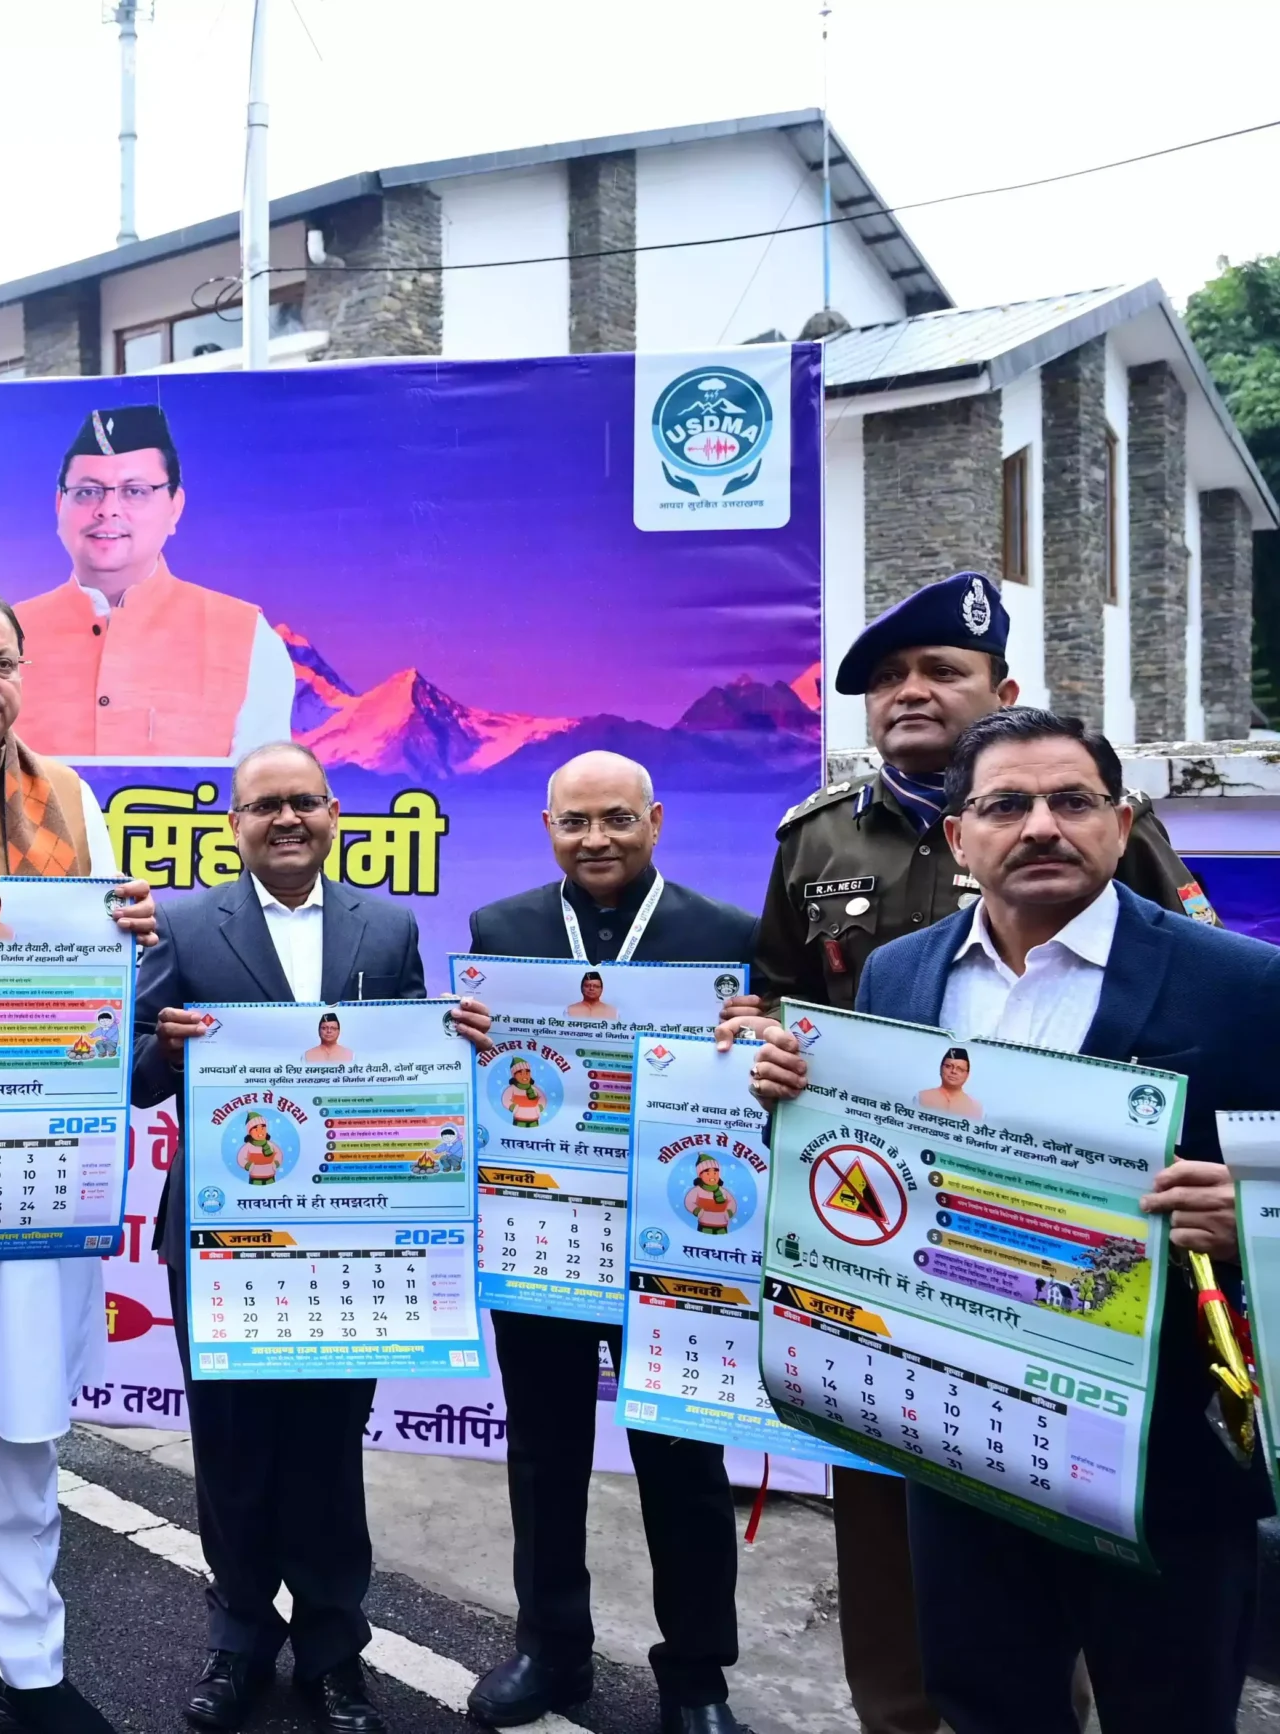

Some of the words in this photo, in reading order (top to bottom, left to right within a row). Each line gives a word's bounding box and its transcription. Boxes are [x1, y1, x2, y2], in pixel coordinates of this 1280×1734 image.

[666, 415, 758, 444] USDMA
[659, 502, 683, 510] आपदा
[688, 499, 718, 511] सुरक्षित
[722, 500, 764, 508] उत्तराखण्ड
[838, 881, 861, 891] NEGI
[6, 942, 22, 952] और
[54, 942, 74, 952] दोनों
[76, 944, 95, 955] बहुत
[97, 944, 122, 953] जरूरी
[478, 1040, 522, 1068] शीतलहर
[526, 1038, 537, 1052] से
[542, 1045, 571, 1073] सुरक्षा
[211, 1092, 258, 1126] शीतलहर
[262, 1089, 274, 1103] से
[277, 1097, 308, 1125] सुरक्षा
[49, 1117, 117, 1135] 2025
[839, 1090, 848, 1101] से
[851, 1095, 877, 1108] बचाव
[880, 1100, 891, 1112] के
[894, 1103, 915, 1119] लिए
[918, 1112, 970, 1132] समझदारी
[973, 1123, 996, 1138] और
[1042, 1139, 1073, 1154] दोनों
[1075, 1146, 1104, 1164] बहुत
[1107, 1154, 1149, 1172] जरूरी
[501, 1138, 556, 1152] सावधानी
[560, 1140, 570, 1153] में
[574, 1142, 589, 1156] ही
[657, 1134, 711, 1164] शीतलहर
[716, 1132, 728, 1147] से
[732, 1140, 768, 1173] सुरक्षा
[840, 1124, 850, 1138] से
[854, 1128, 885, 1150] सुरक्षा
[887, 1145, 899, 1159] के
[896, 1159, 918, 1192] उपाय
[491, 1171, 535, 1184] जनवरी
[236, 1195, 293, 1210] सावधानी
[297, 1194, 307, 1209] में
[311, 1195, 325, 1210] ही
[329, 1195, 388, 1211] समझदारी
[198, 1234, 205, 1245] 1
[229, 1232, 272, 1244] जनवरी
[395, 1229, 465, 1245] 2025
[683, 1245, 747, 1266] सावधानी
[637, 1275, 645, 1289] 1
[673, 1281, 723, 1298] जनवरी
[771, 1283, 782, 1298] 7
[822, 1253, 891, 1290] सावधानी
[896, 1271, 911, 1292] में
[915, 1280, 936, 1301] ही
[939, 1290, 1022, 1328] समझदारी
[809, 1295, 856, 1325] जुलाई
[1024, 1364, 1130, 1417] 2025
[121, 1384, 185, 1417] तथा
